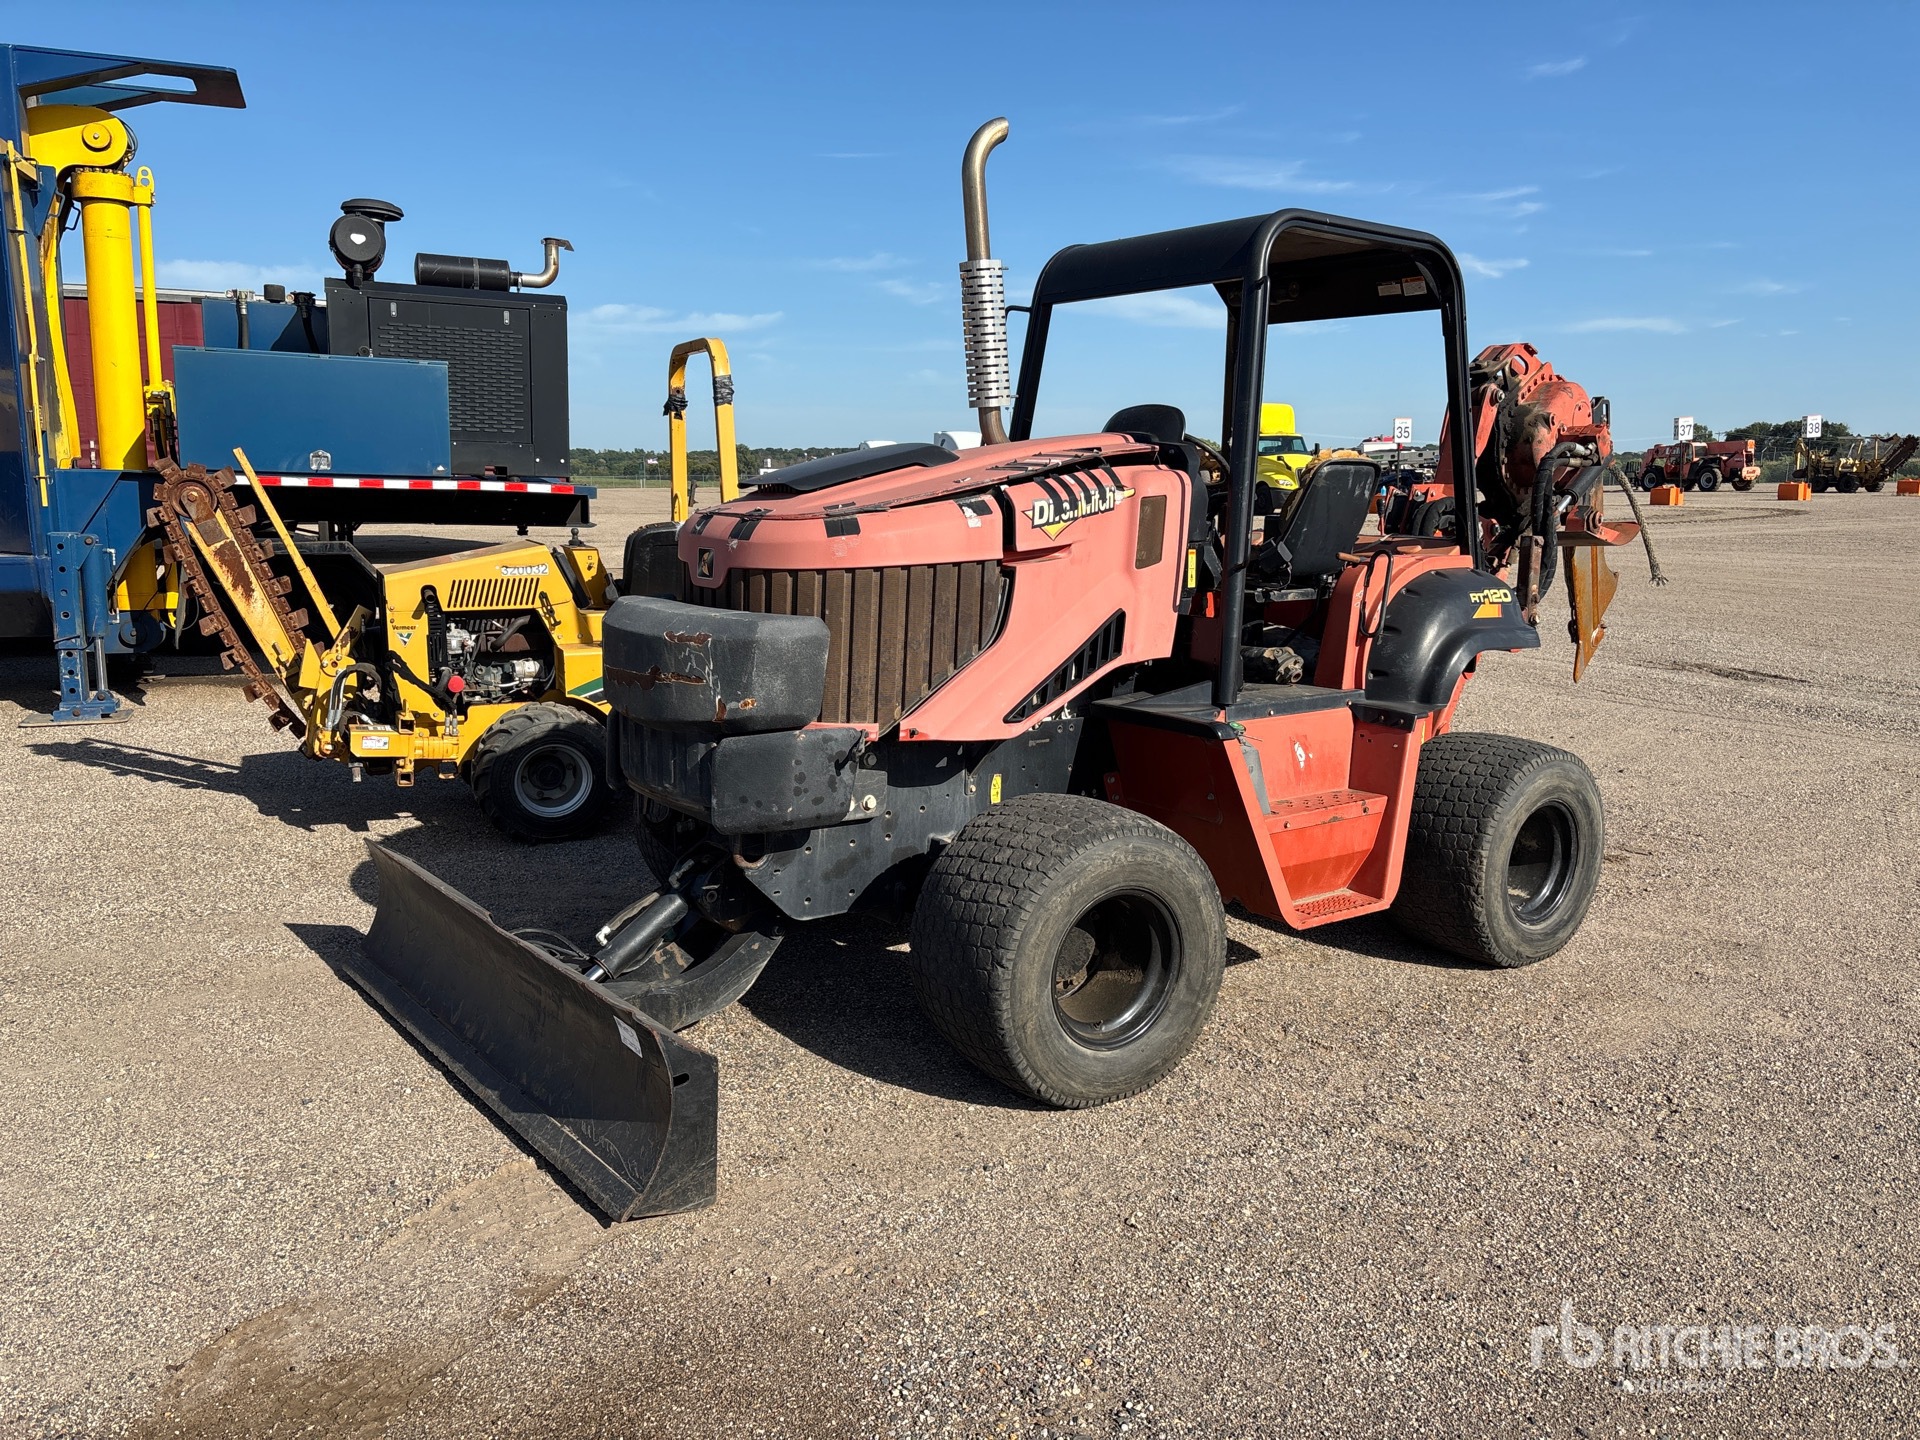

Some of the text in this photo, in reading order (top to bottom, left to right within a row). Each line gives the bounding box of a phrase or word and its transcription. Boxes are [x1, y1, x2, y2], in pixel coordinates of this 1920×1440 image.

[1396, 426, 1410, 439] 35
[1680, 424, 1692, 436] 37
[1808, 422, 1820, 434] 38
[1469, 589, 1512, 603] RT120
